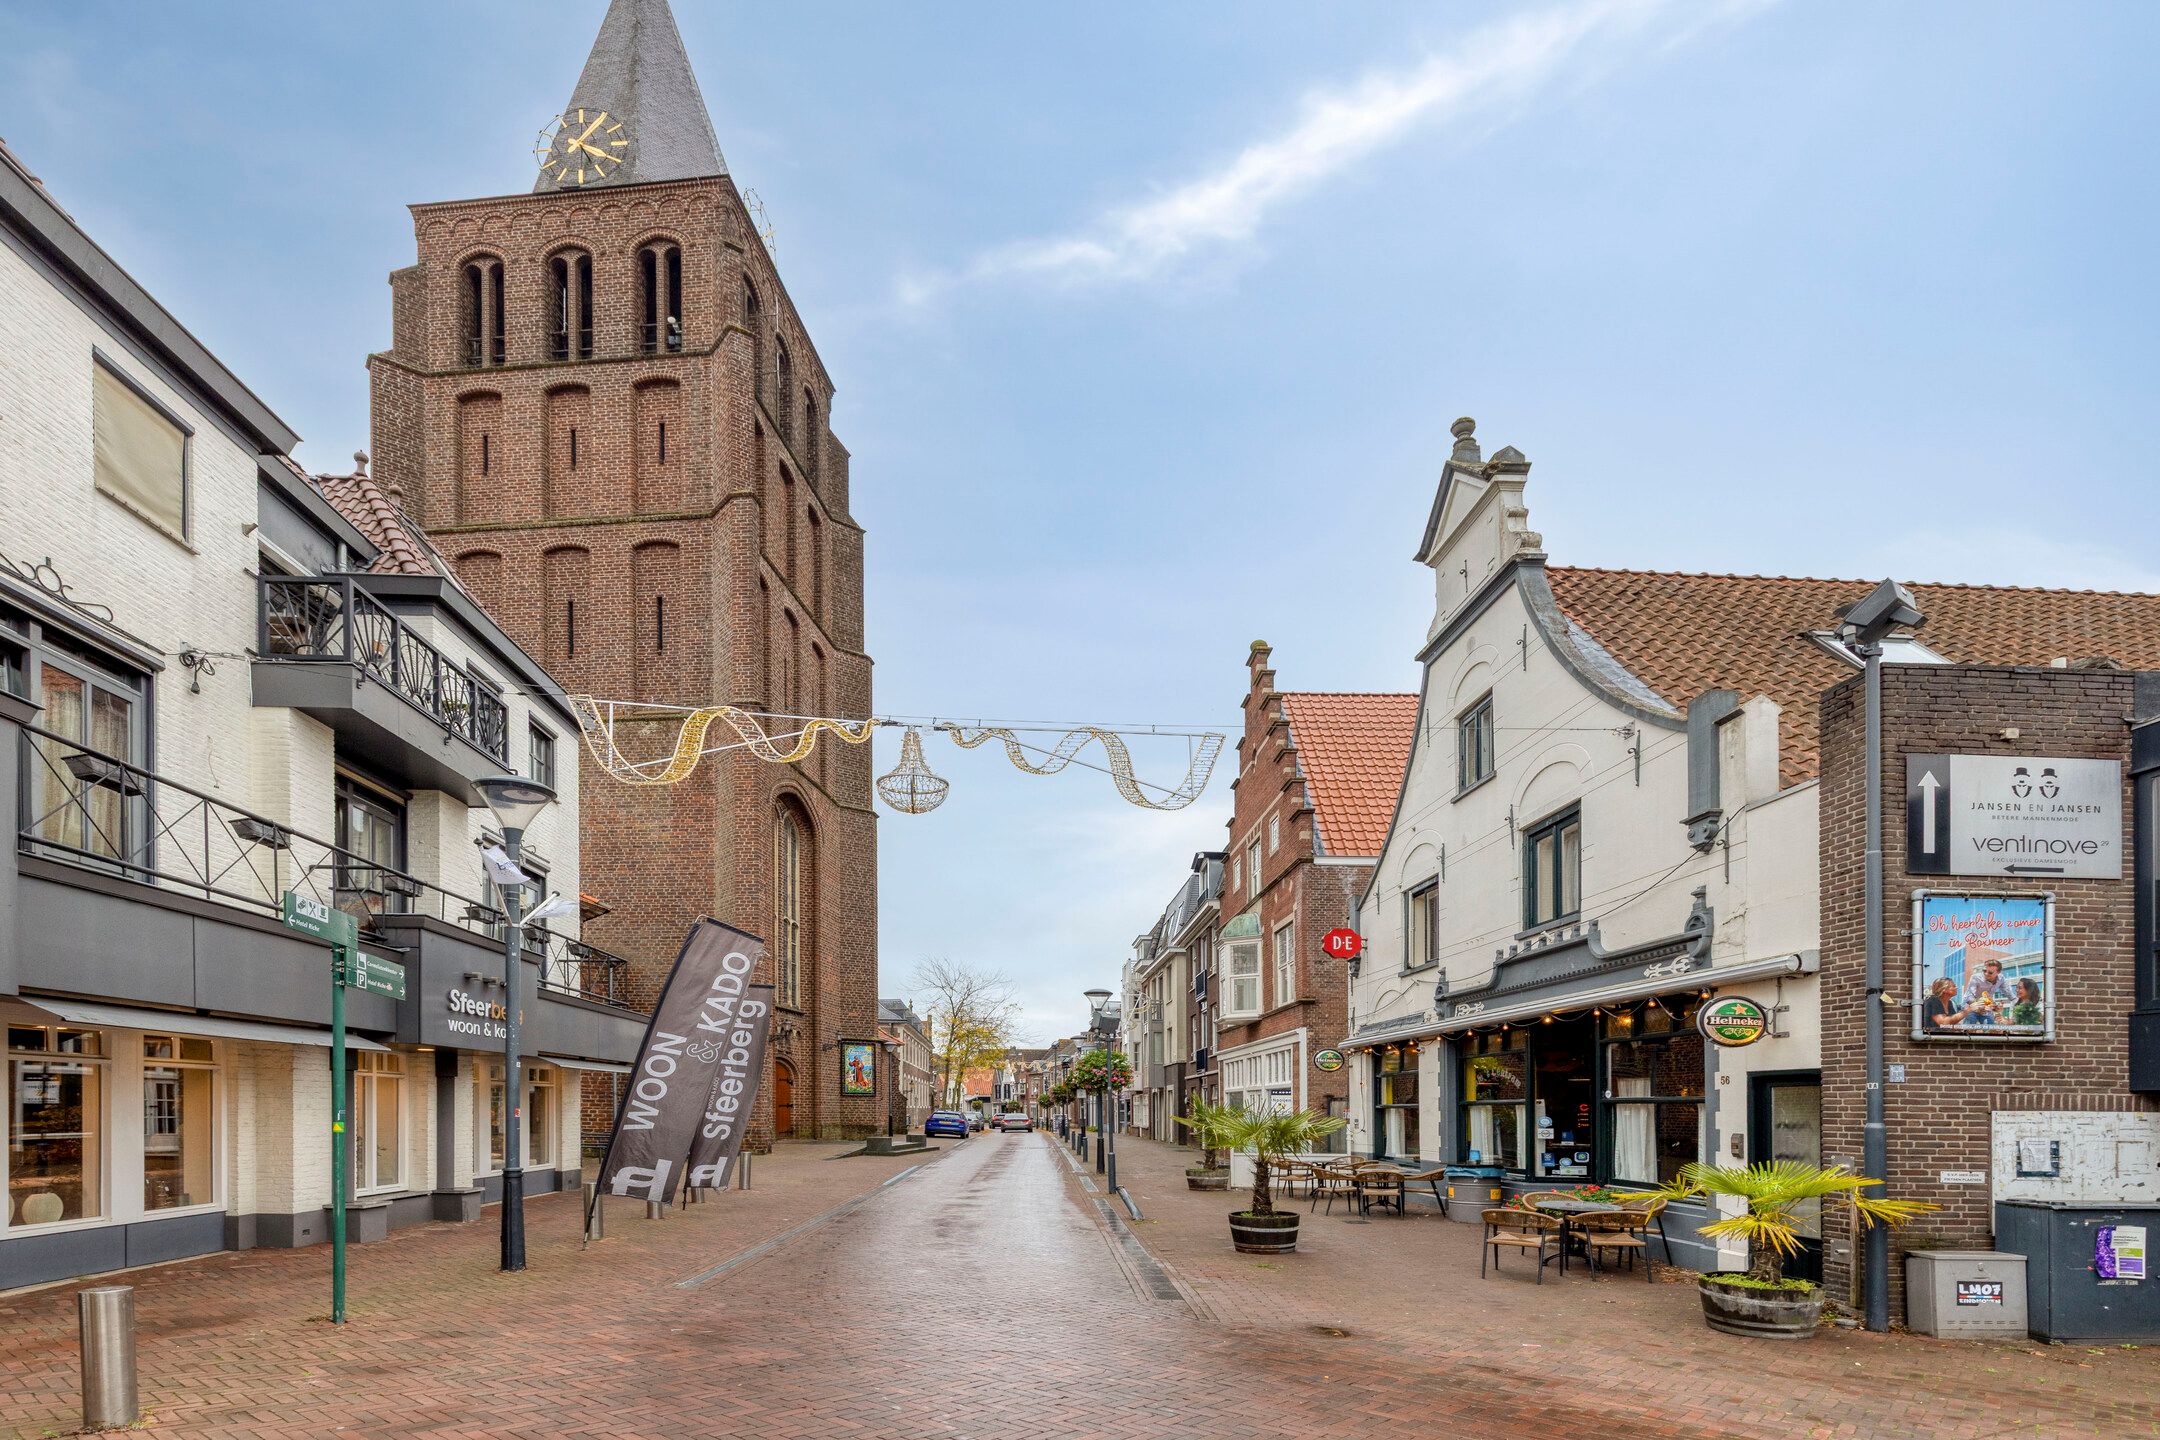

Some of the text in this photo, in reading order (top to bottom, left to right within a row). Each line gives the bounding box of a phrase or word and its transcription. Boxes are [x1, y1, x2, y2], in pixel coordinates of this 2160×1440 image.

[1971, 802, 2101, 813] JANSEN EN JANSEN
[1972, 835, 2098, 855] ventinove
[1929, 911, 2041, 938] Oh heerlijke zomer
[1949, 931, 2015, 949] in Boxmeer
[448, 1020, 481, 1036] woon
[483, 1022, 492, 1037] &
[623, 952, 750, 1131] WOON & KADO
[702, 1000, 766, 1140] Sfeerberg
[1720, 1075, 1731, 1085] 56
